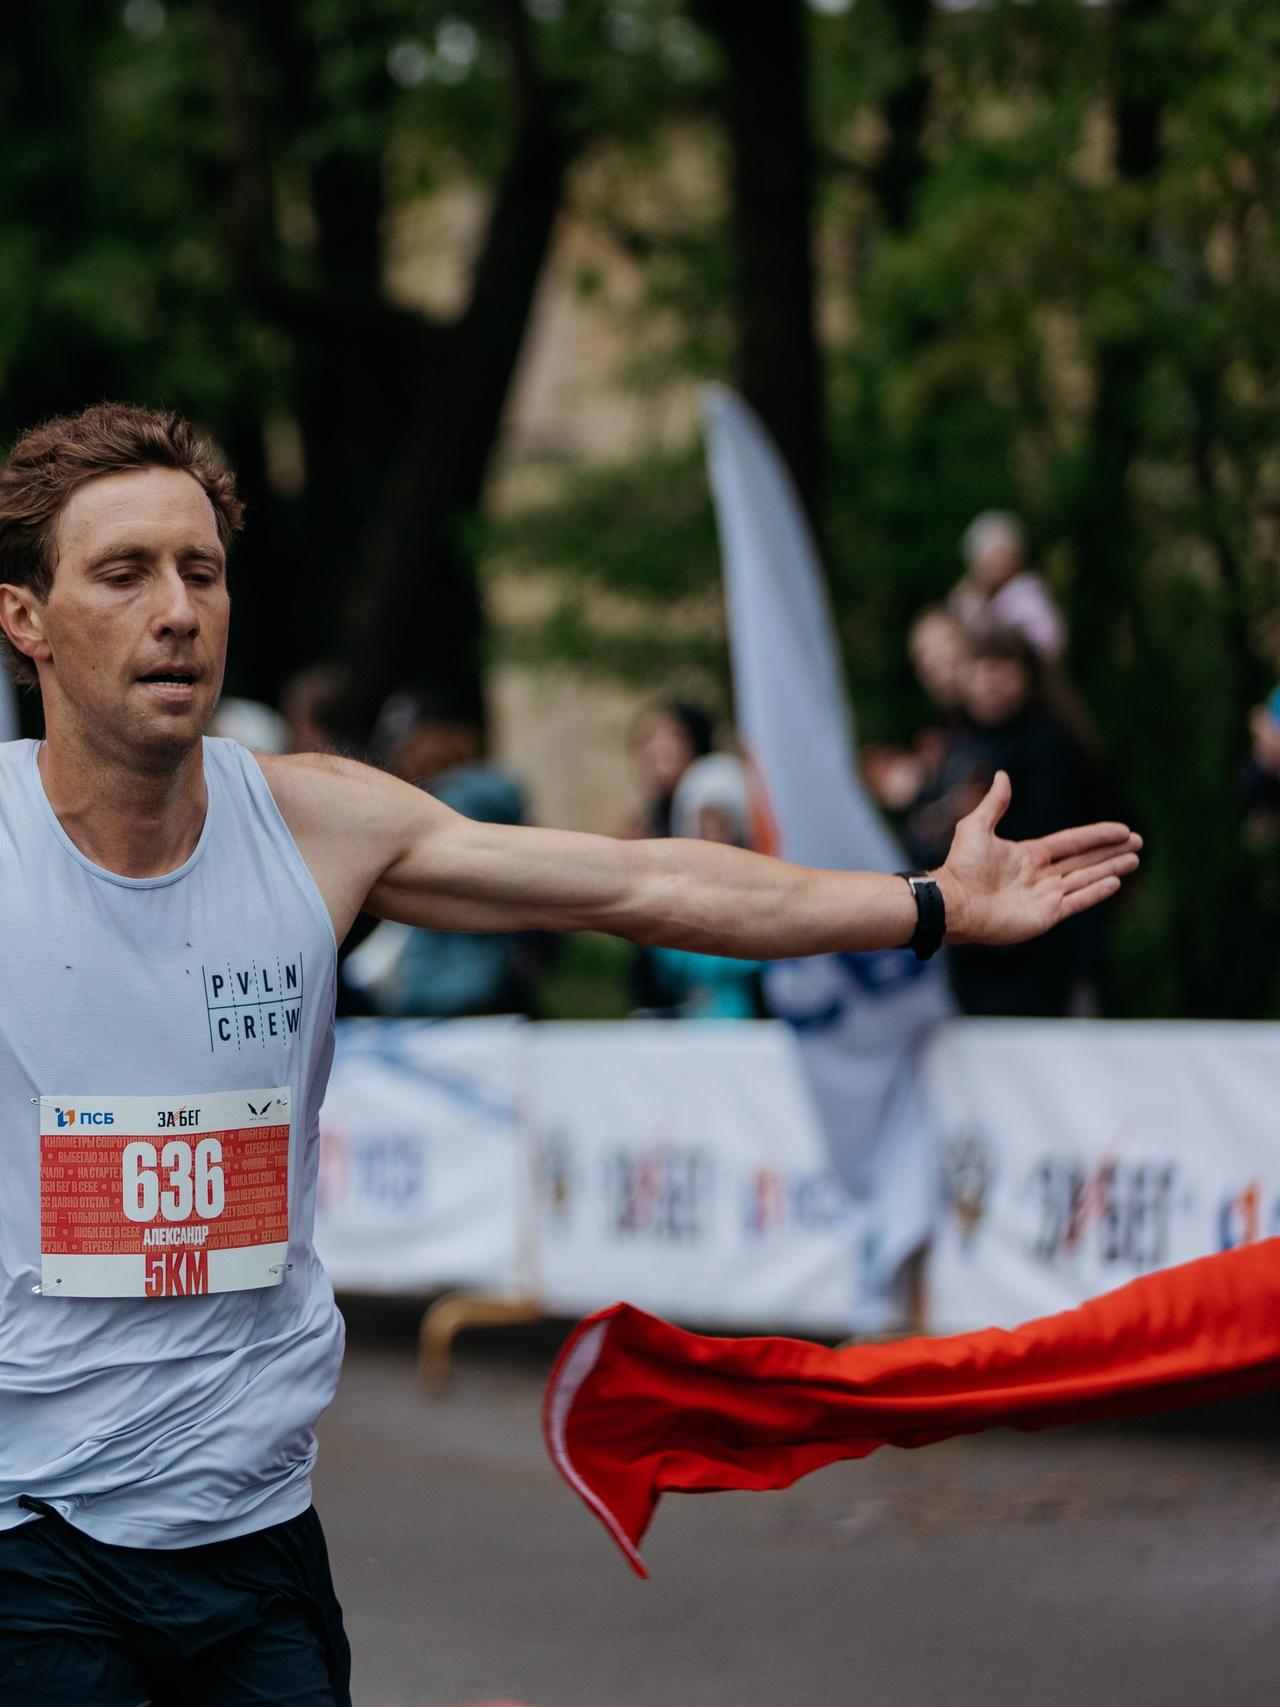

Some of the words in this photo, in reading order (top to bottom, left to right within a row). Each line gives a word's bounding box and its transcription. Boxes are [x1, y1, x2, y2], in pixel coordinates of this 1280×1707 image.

[211, 964, 297, 998] PVLN
[218, 1007, 300, 1042] CREW
[80, 1112, 114, 1125] ПСБ
[44, 1136, 95, 1148] КИЛОМЕТРЫ
[258, 1127, 271, 1139] БЕГ
[270, 1126, 277, 1138] В
[245, 1142, 269, 1155] СТРЕСС
[58, 1151, 97, 1163] ВЫБЕГАЮ
[98, 1151, 109, 1163] ЗА
[77, 1167, 89, 1179] НА
[89, 1167, 118, 1179] СТАРТЕ
[122, 1138, 225, 1222] 636
[230, 1174, 248, 1188] ПОКА
[248, 1172, 260, 1185] ВСЕ
[56, 1181, 70, 1193] БЕГ
[71, 1181, 78, 1193] В
[78, 1181, 99, 1193] СЕБЕ
[51, 1196, 79, 1209] ДАВНО
[79, 1196, 110, 1208] ОТСТАЛ
[237, 1203, 254, 1216] ВСЕМ
[254, 1200, 283, 1215] СЕРДЦЕМ
[67, 1211, 99, 1223] ТОЛЬКО
[73, 1226, 99, 1238] ЛЮБИ
[99, 1226, 114, 1238] БЕГ
[114, 1226, 121, 1238] В
[121, 1226, 141, 1238] СЕБЕ
[143, 1225, 209, 1246] АЛЕКСАНДР
[82, 1241, 114, 1253] СТРЕСС
[113, 1241, 141, 1254] ДАВНО
[219, 1235, 230, 1248] ЗА
